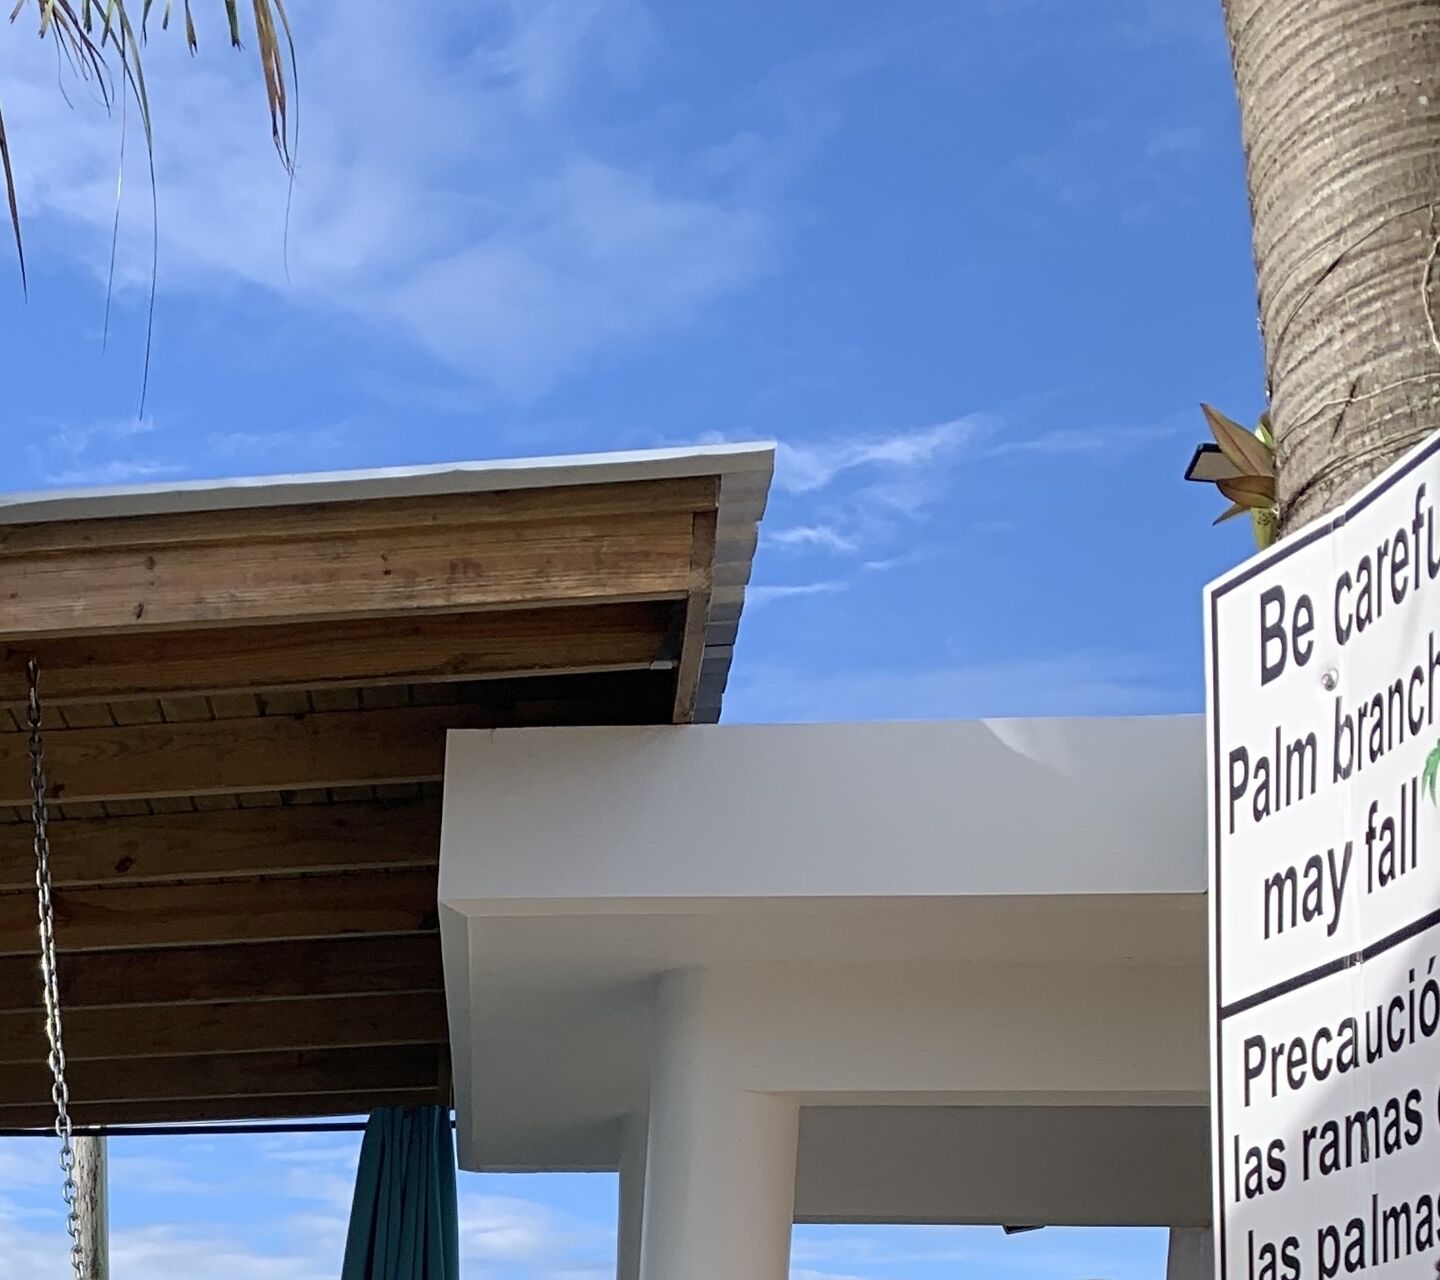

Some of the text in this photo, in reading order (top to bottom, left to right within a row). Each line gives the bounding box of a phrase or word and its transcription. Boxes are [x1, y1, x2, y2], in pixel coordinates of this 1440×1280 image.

[1260, 585, 1314, 686] Be
[1229, 726, 1317, 835] Palm
[1264, 777, 1418, 940] may fall
[1244, 955, 1440, 1107] Precaució
[1234, 1134, 1287, 1203] las
[1302, 1088, 1423, 1182] ramas
